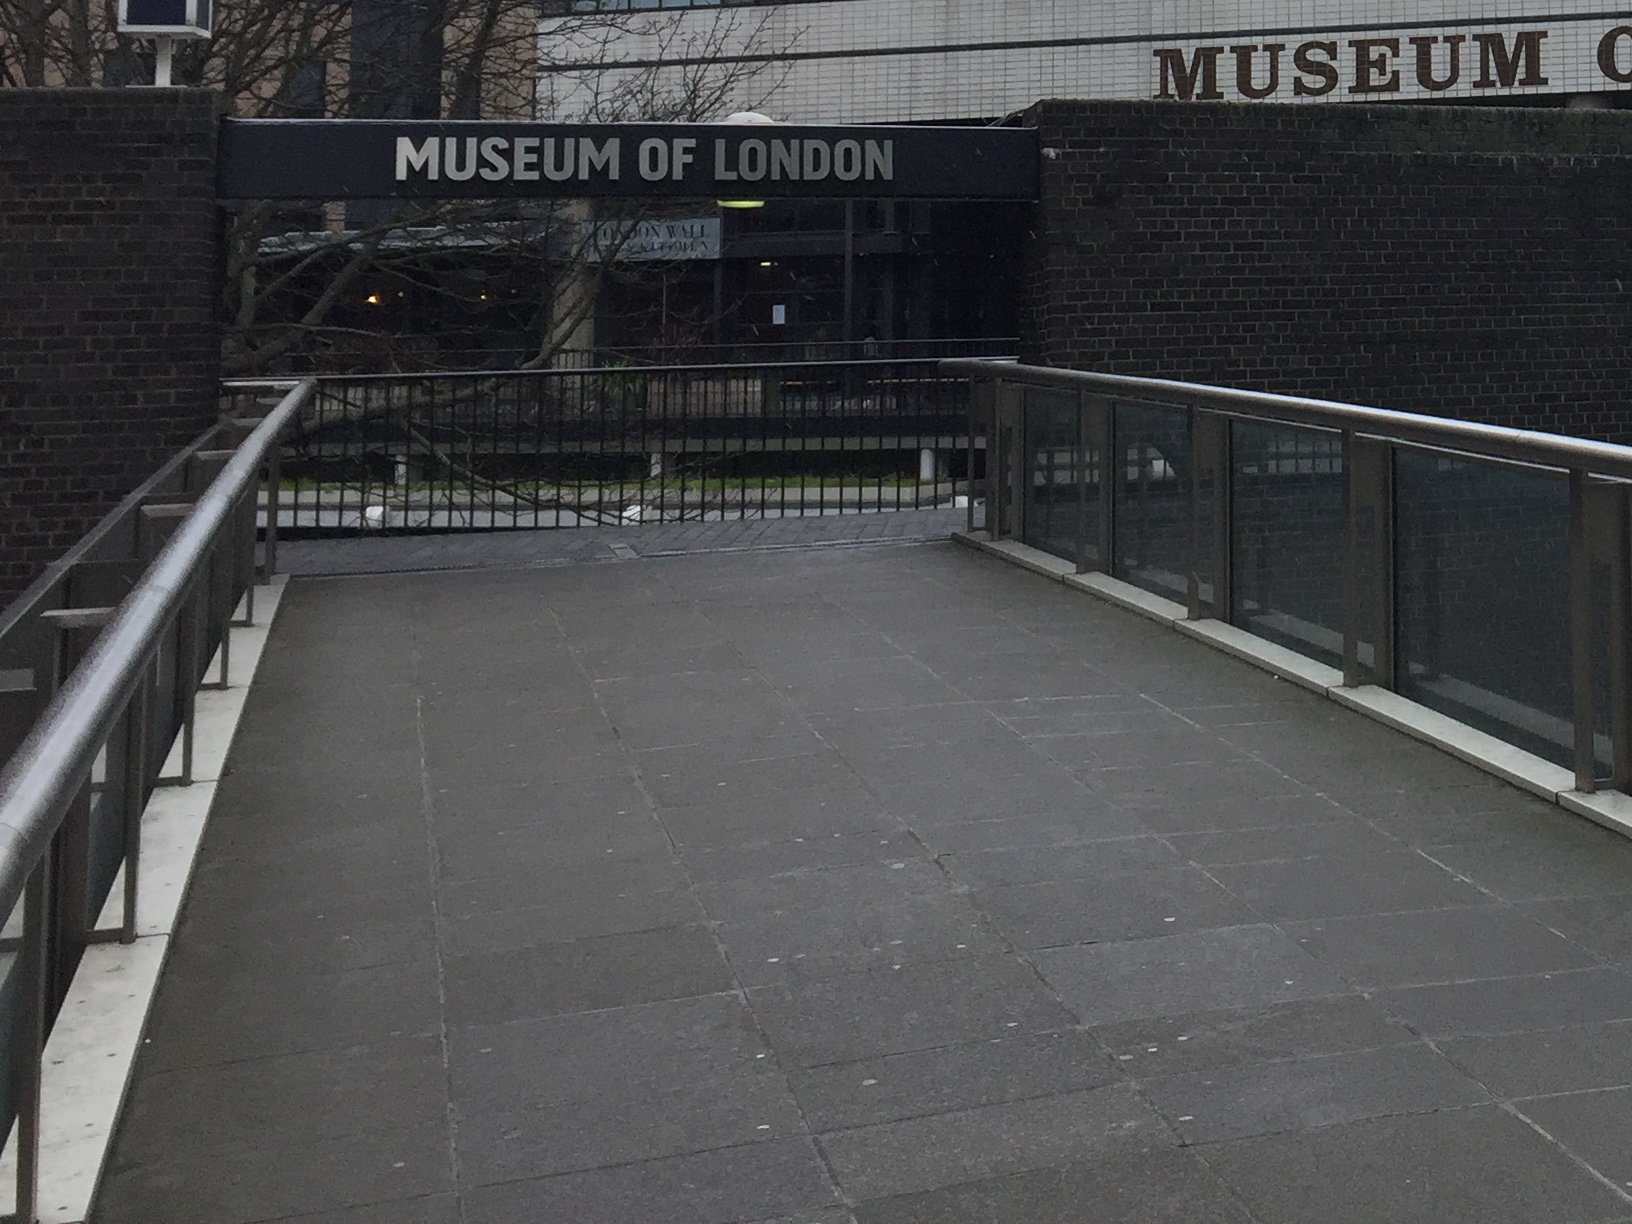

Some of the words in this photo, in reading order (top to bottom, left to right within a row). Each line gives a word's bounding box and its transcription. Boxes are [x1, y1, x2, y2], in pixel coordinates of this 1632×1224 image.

[1152, 30, 1549, 101] MUSEUM
[395, 136, 621, 182] MUSEUM
[638, 137, 697, 182] OF
[714, 138, 894, 182] LONDON
[666, 224, 711, 239] WALL
